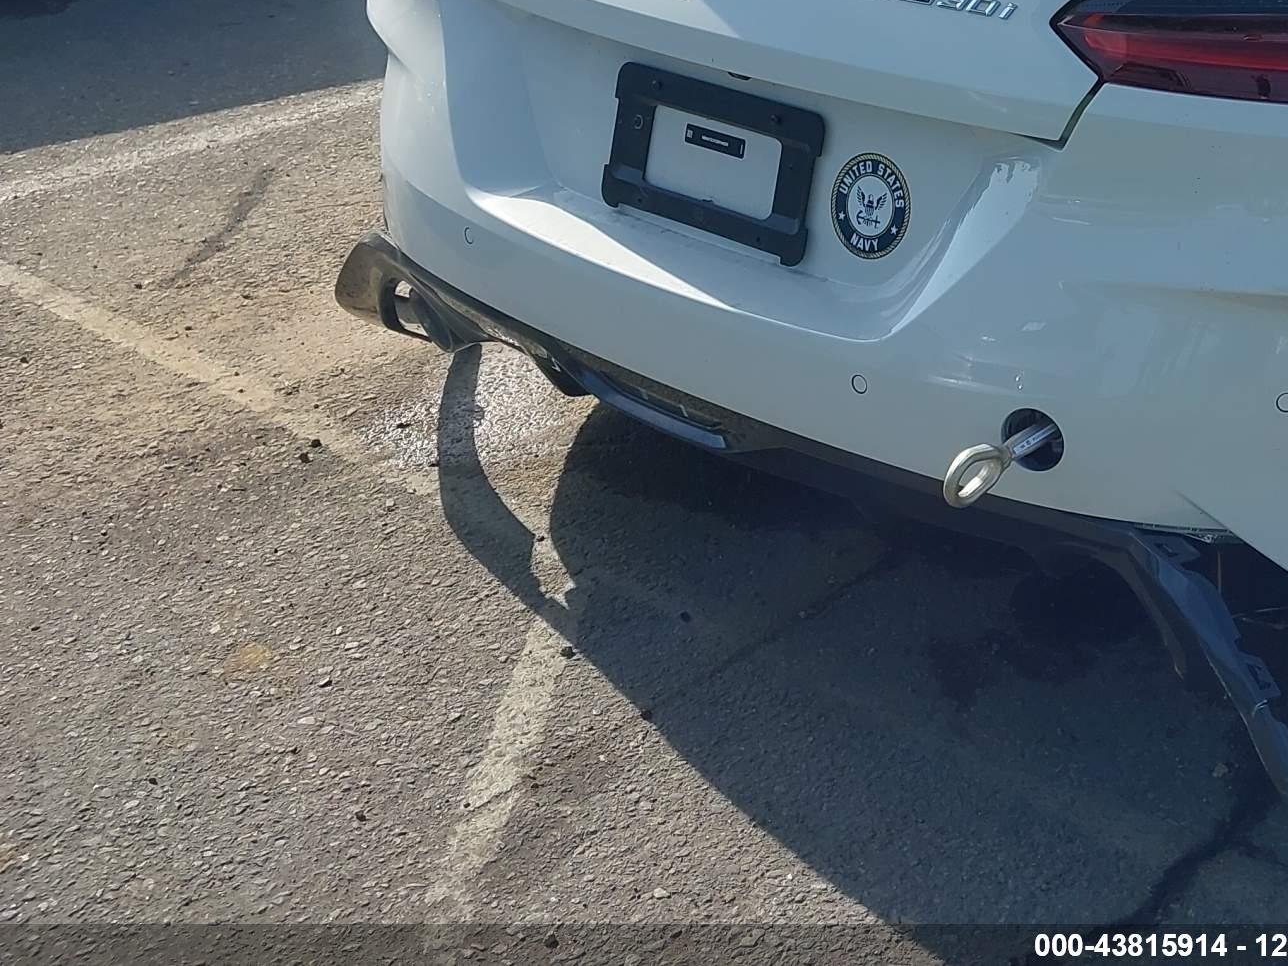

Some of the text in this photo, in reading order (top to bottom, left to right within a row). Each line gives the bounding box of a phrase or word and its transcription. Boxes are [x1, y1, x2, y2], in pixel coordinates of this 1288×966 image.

[839, 160, 905, 208] UNITED STATES
[850, 232, 879, 252] NAVY
